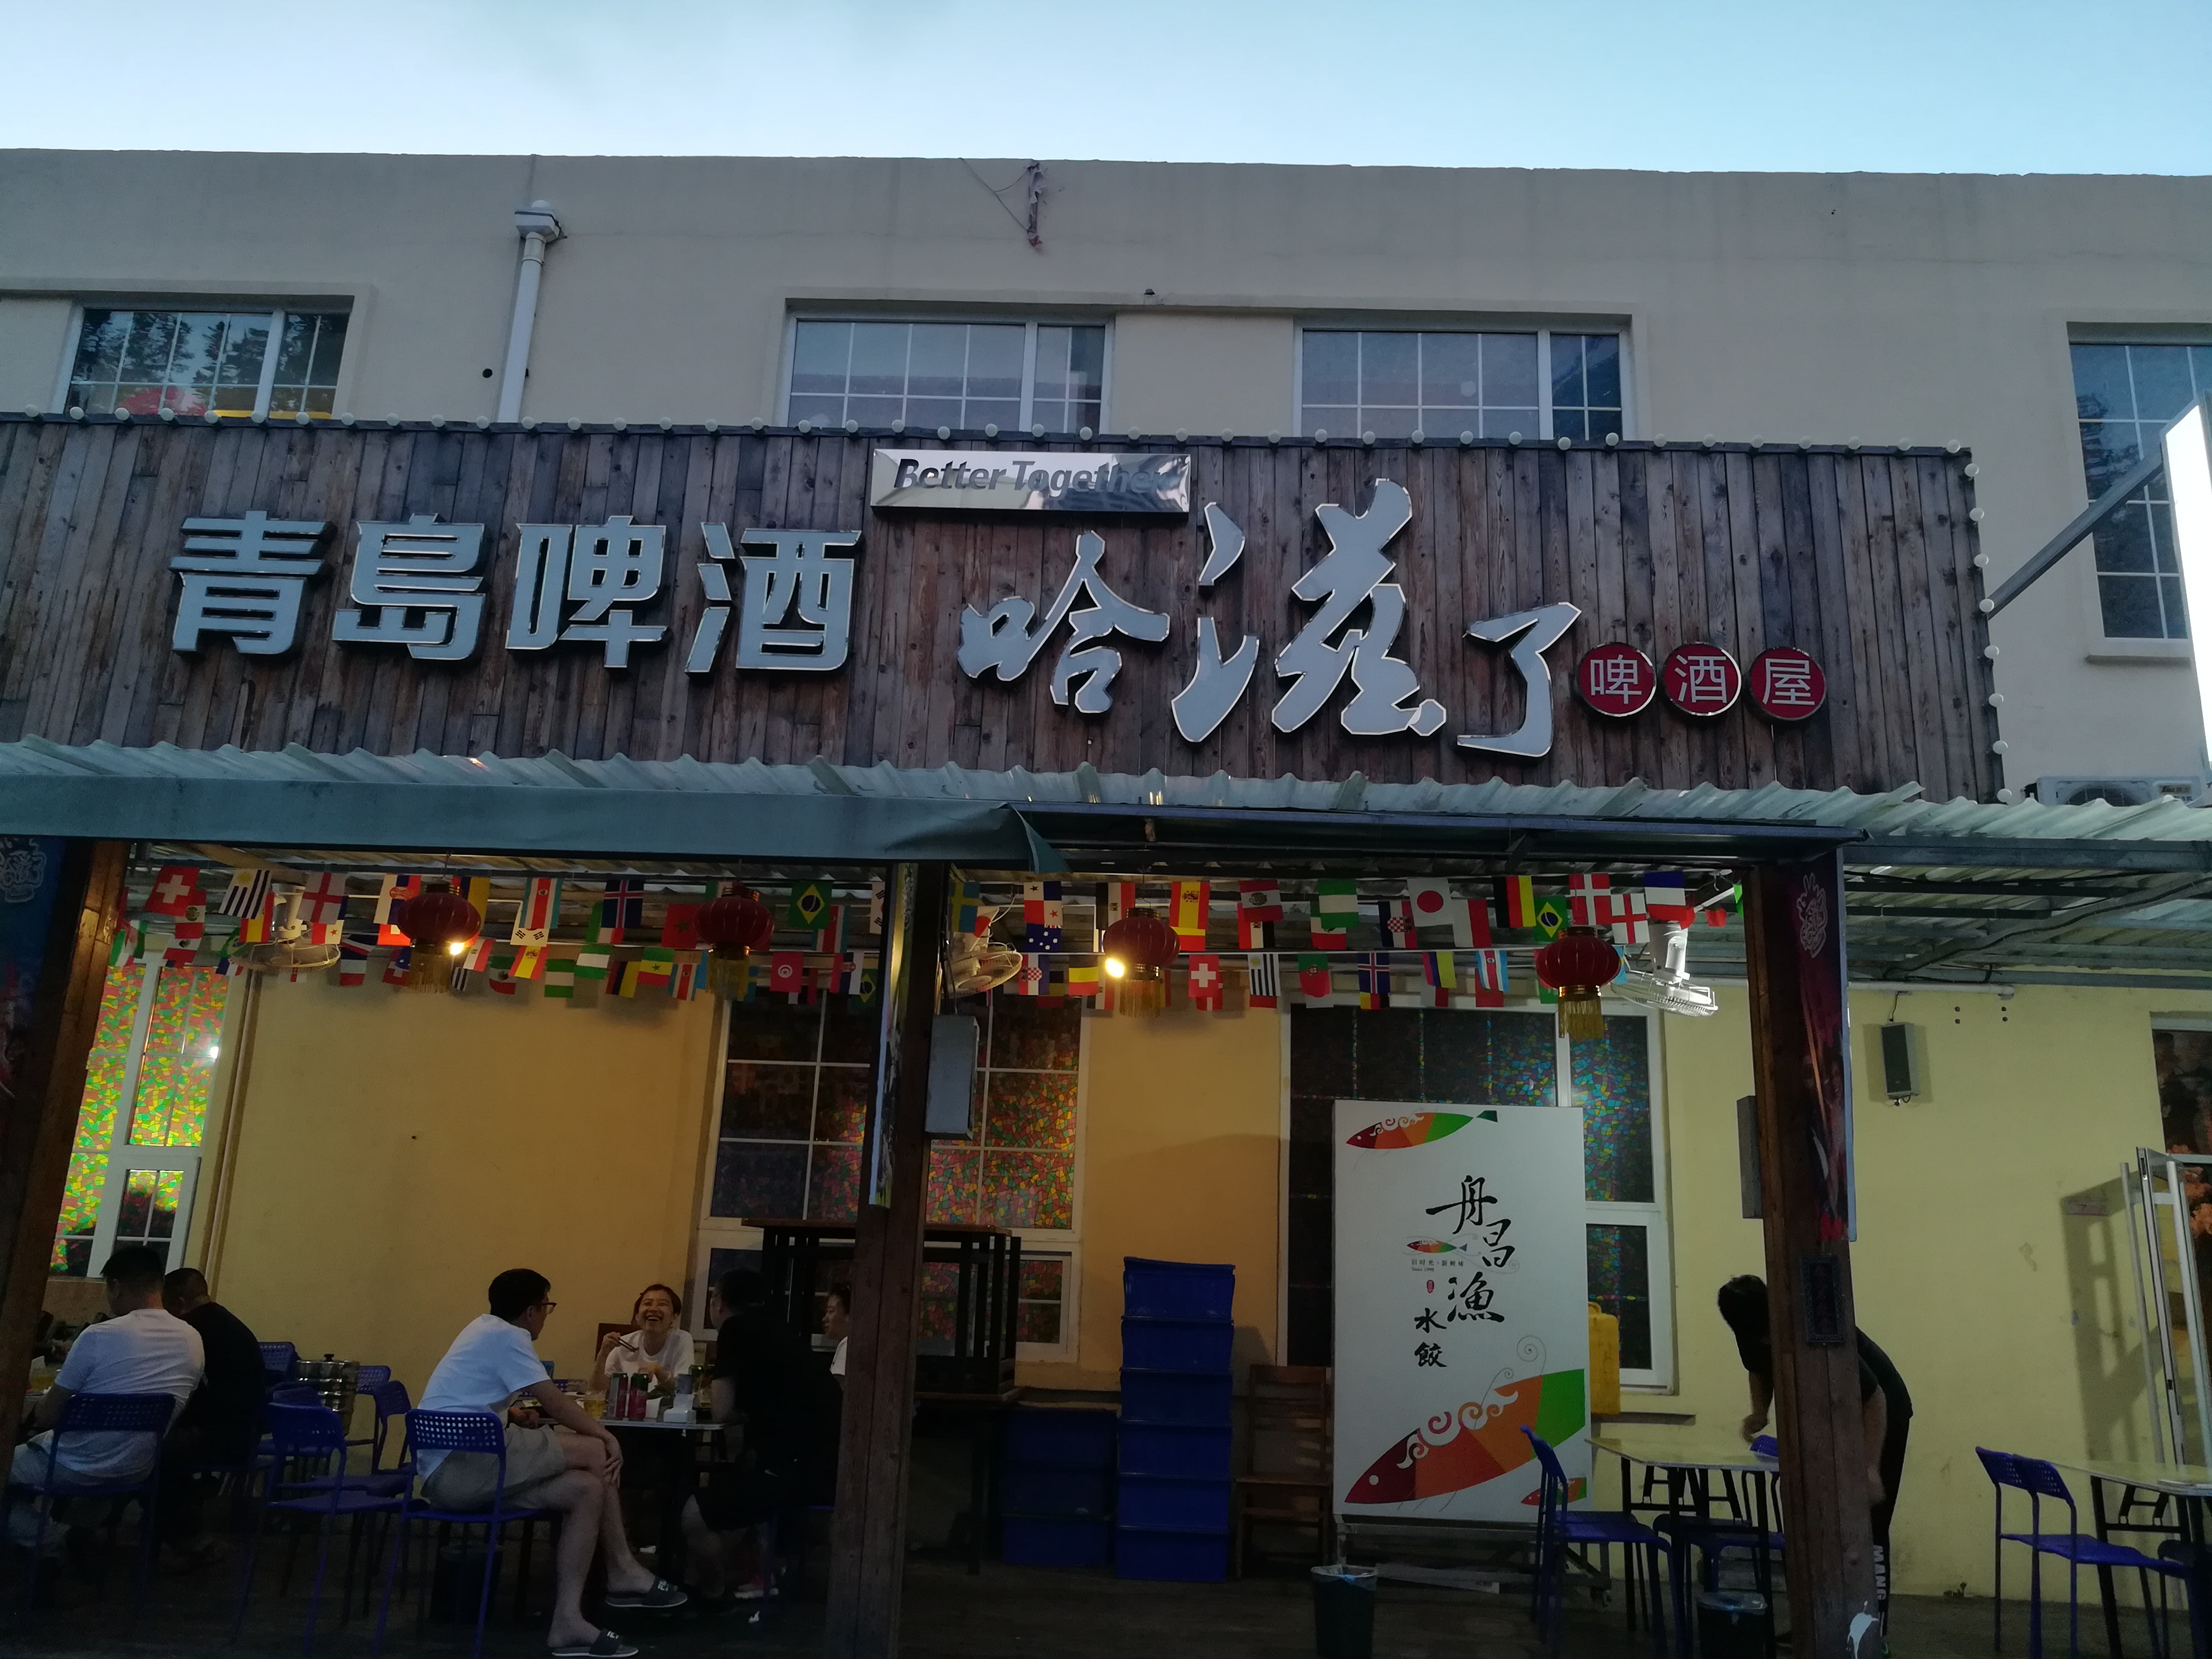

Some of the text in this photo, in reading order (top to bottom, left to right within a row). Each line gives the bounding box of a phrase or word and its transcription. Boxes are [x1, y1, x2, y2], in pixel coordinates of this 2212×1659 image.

[894, 458, 1168, 498] Better Together
[169, 510, 862, 675] 青島啤酒
[1588, 654, 1817, 709] 啤酒屋
